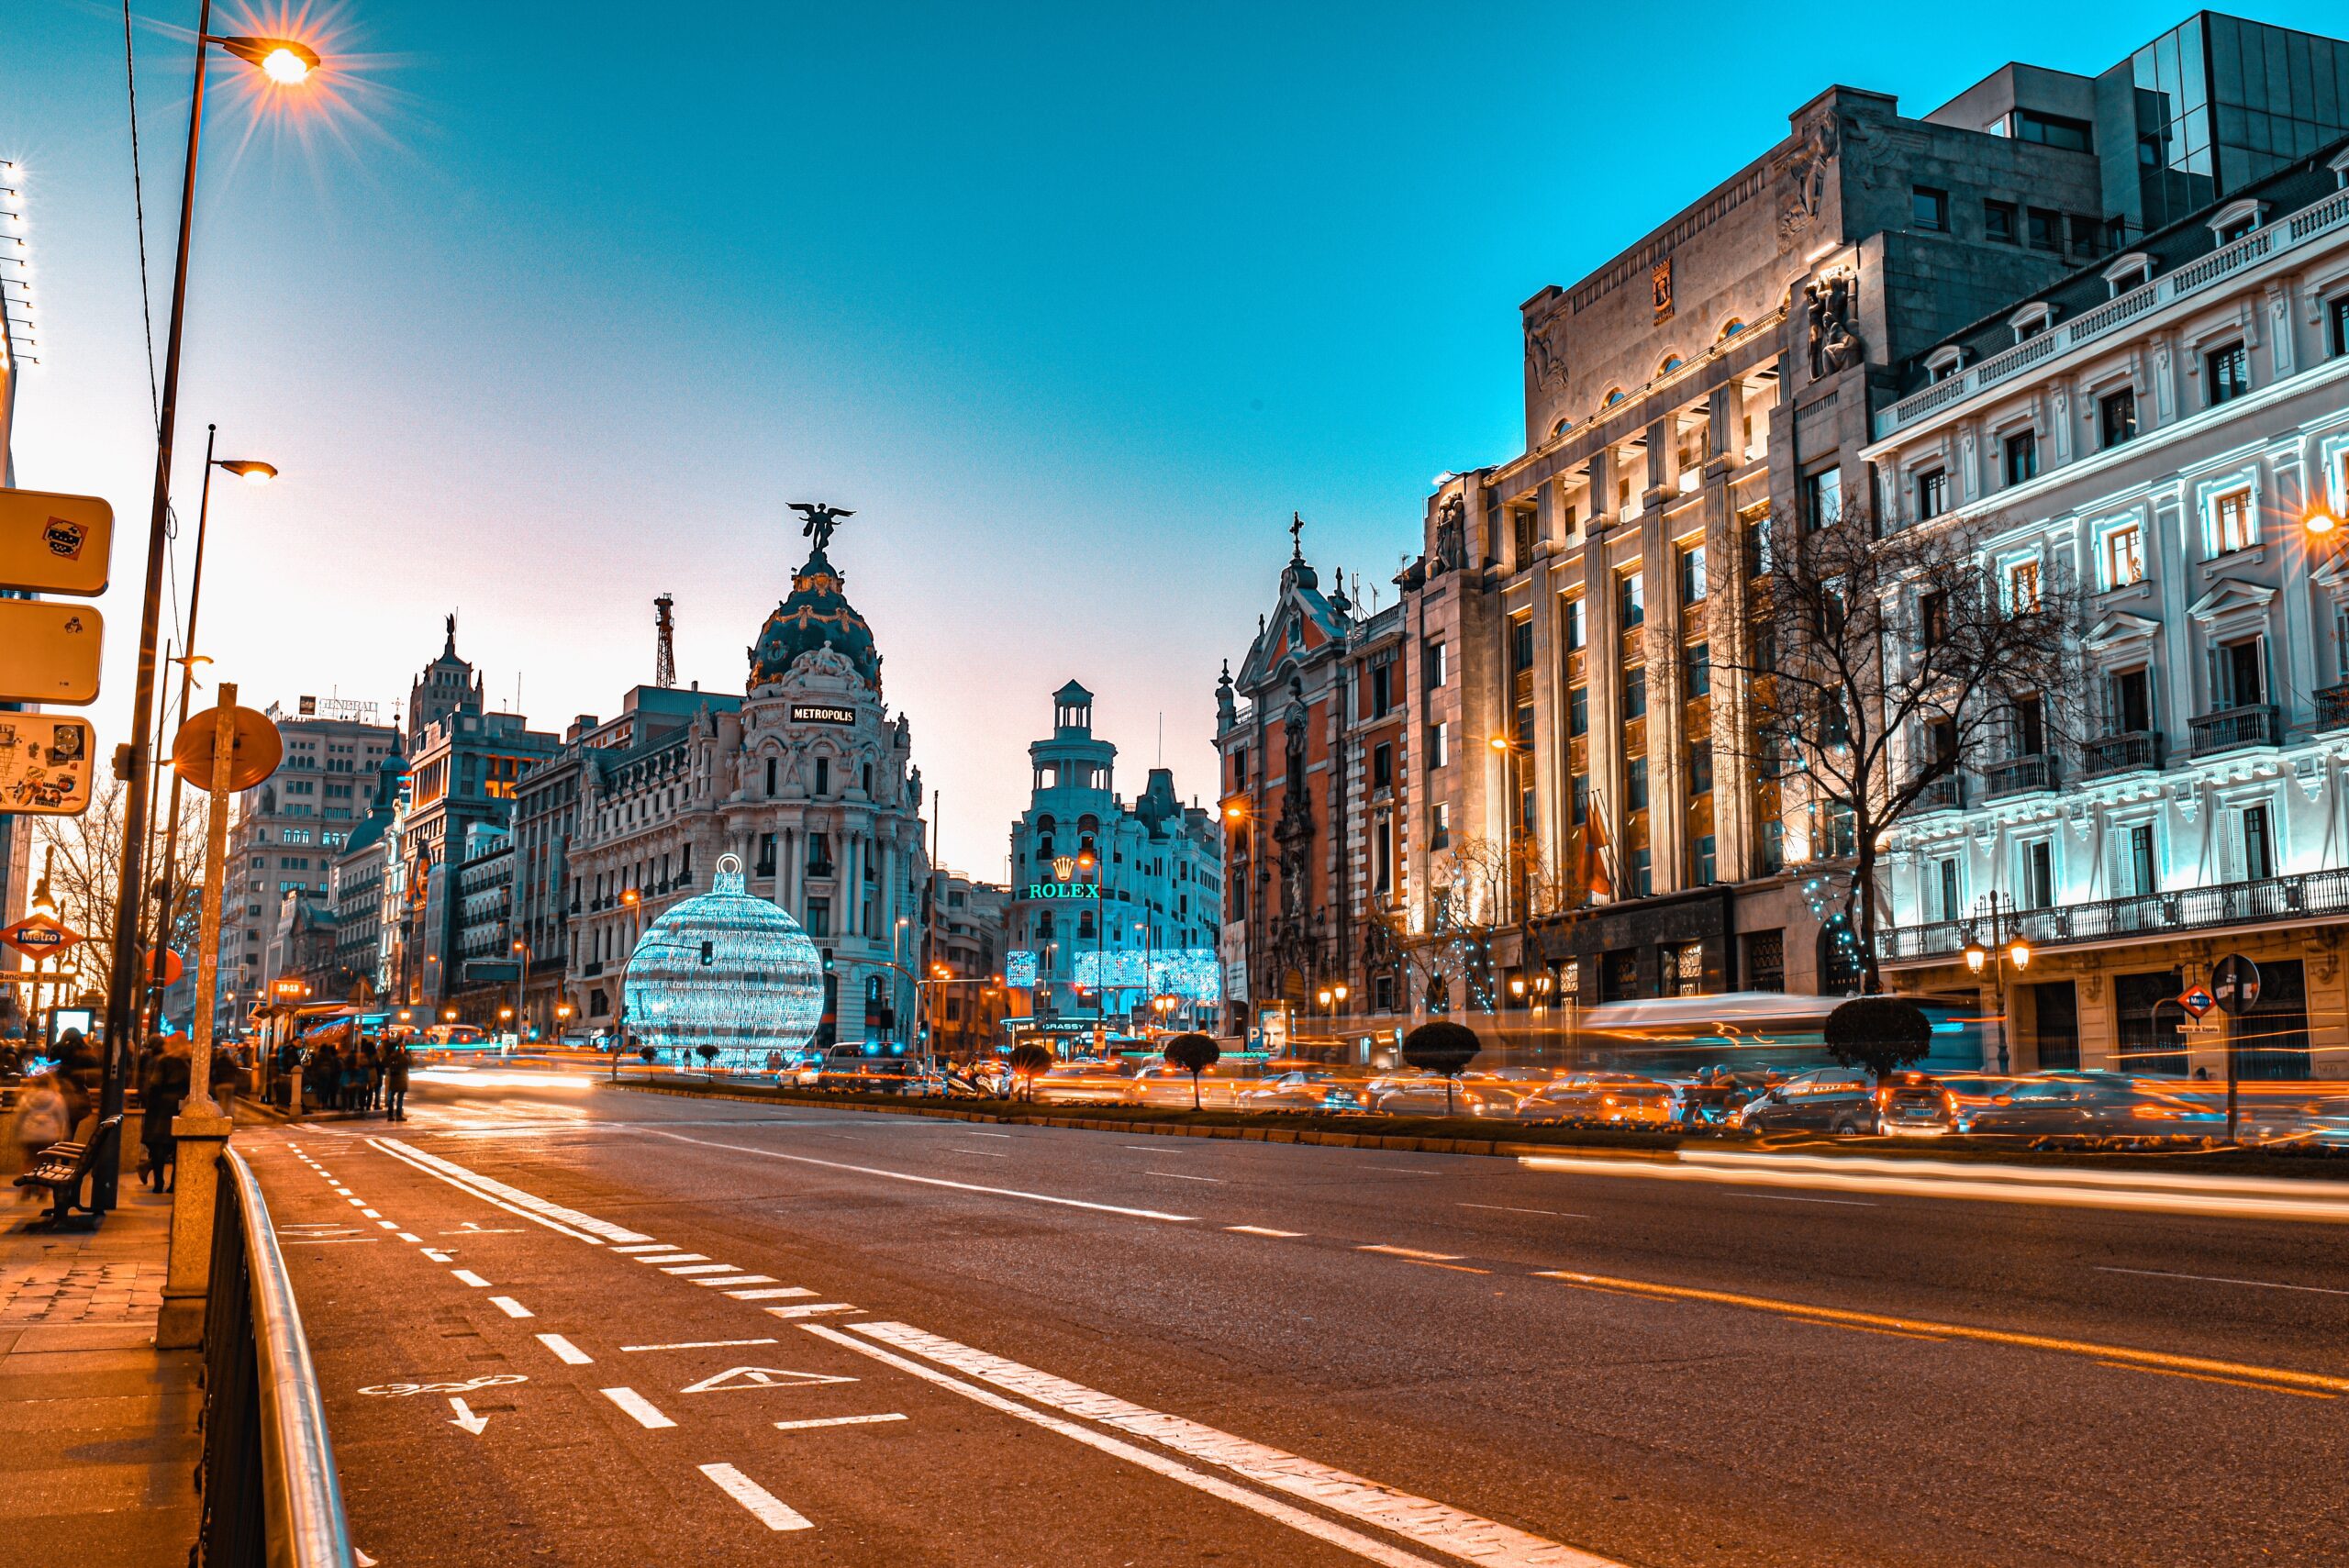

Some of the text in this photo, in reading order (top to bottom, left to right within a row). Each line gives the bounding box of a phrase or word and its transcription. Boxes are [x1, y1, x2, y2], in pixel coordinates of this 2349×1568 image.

[1653, 306, 1675, 327] madrid
[319, 698, 378, 712] GENERALI
[794, 708, 853, 722] METROPOLIS
[1029, 883, 1100, 899] ROLEX
[21, 930, 58, 942] Metro
[0, 973, 24, 981] Banco
[28, 973, 39, 981] de
[2190, 995, 2209, 1005] Metro
[1249, 1028, 1261, 1043] P
